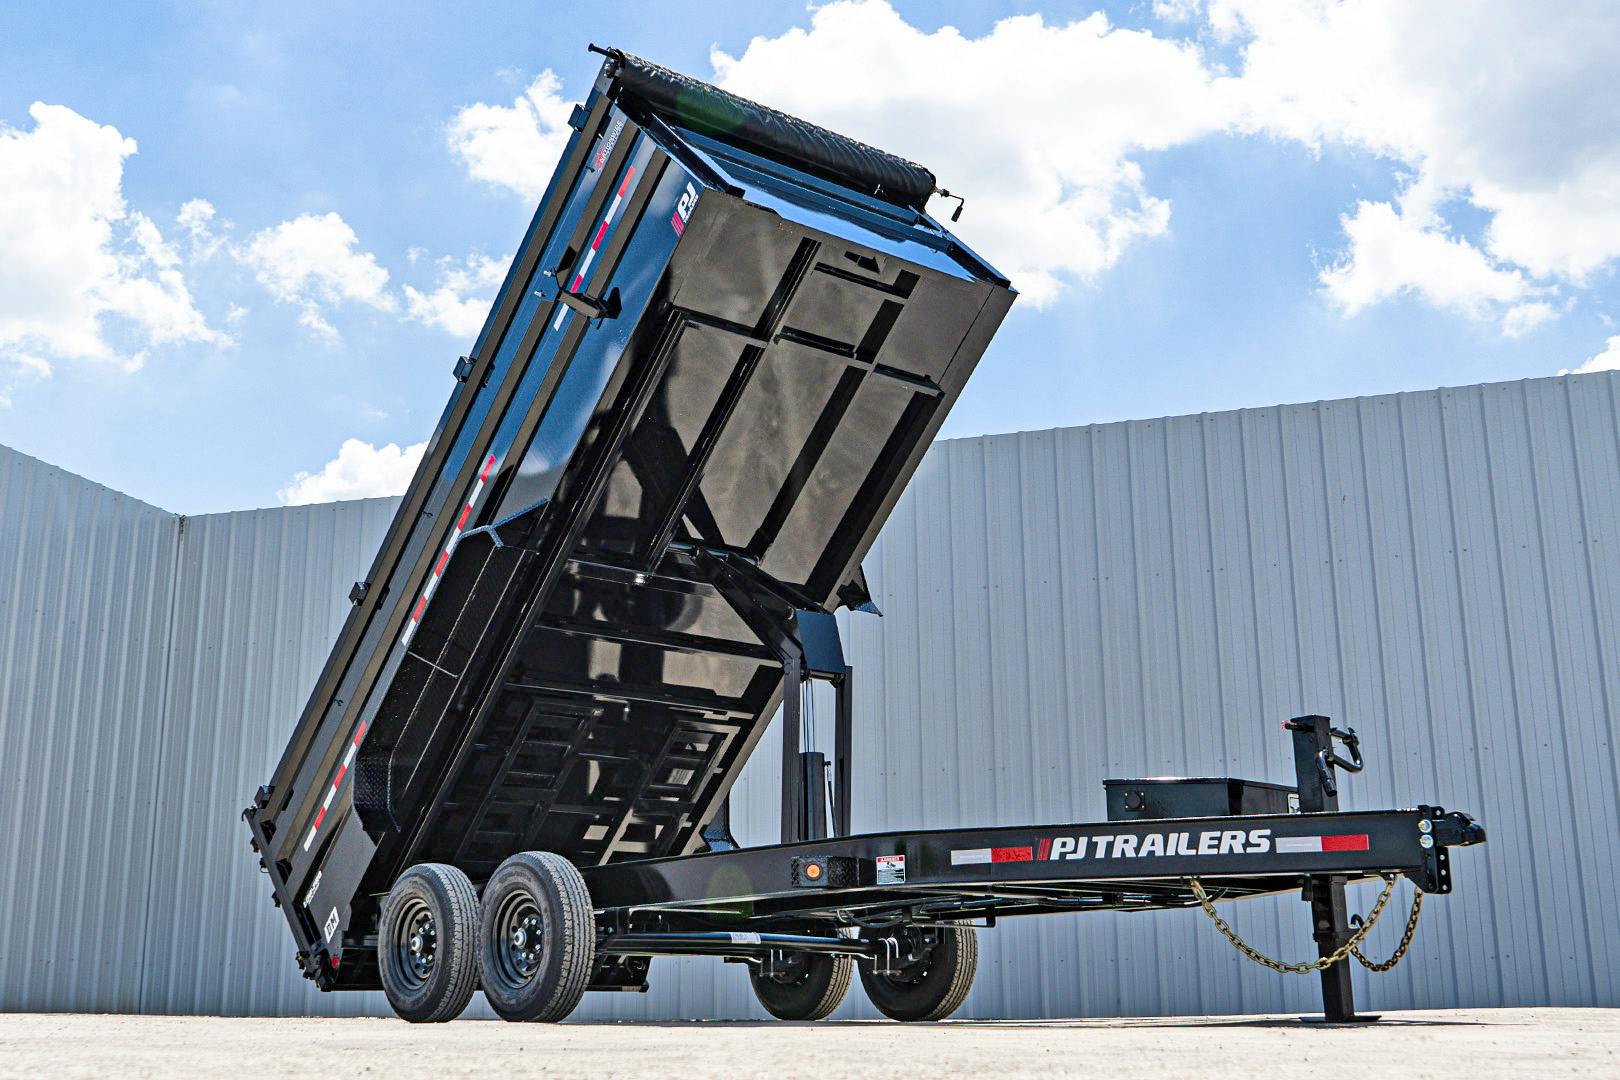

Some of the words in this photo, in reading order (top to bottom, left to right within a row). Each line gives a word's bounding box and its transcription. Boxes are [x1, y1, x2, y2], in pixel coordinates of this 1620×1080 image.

[678, 181, 698, 219] PJ
[1050, 836, 1089, 861] PJ
[1092, 829, 1272, 859] TRAILERS
